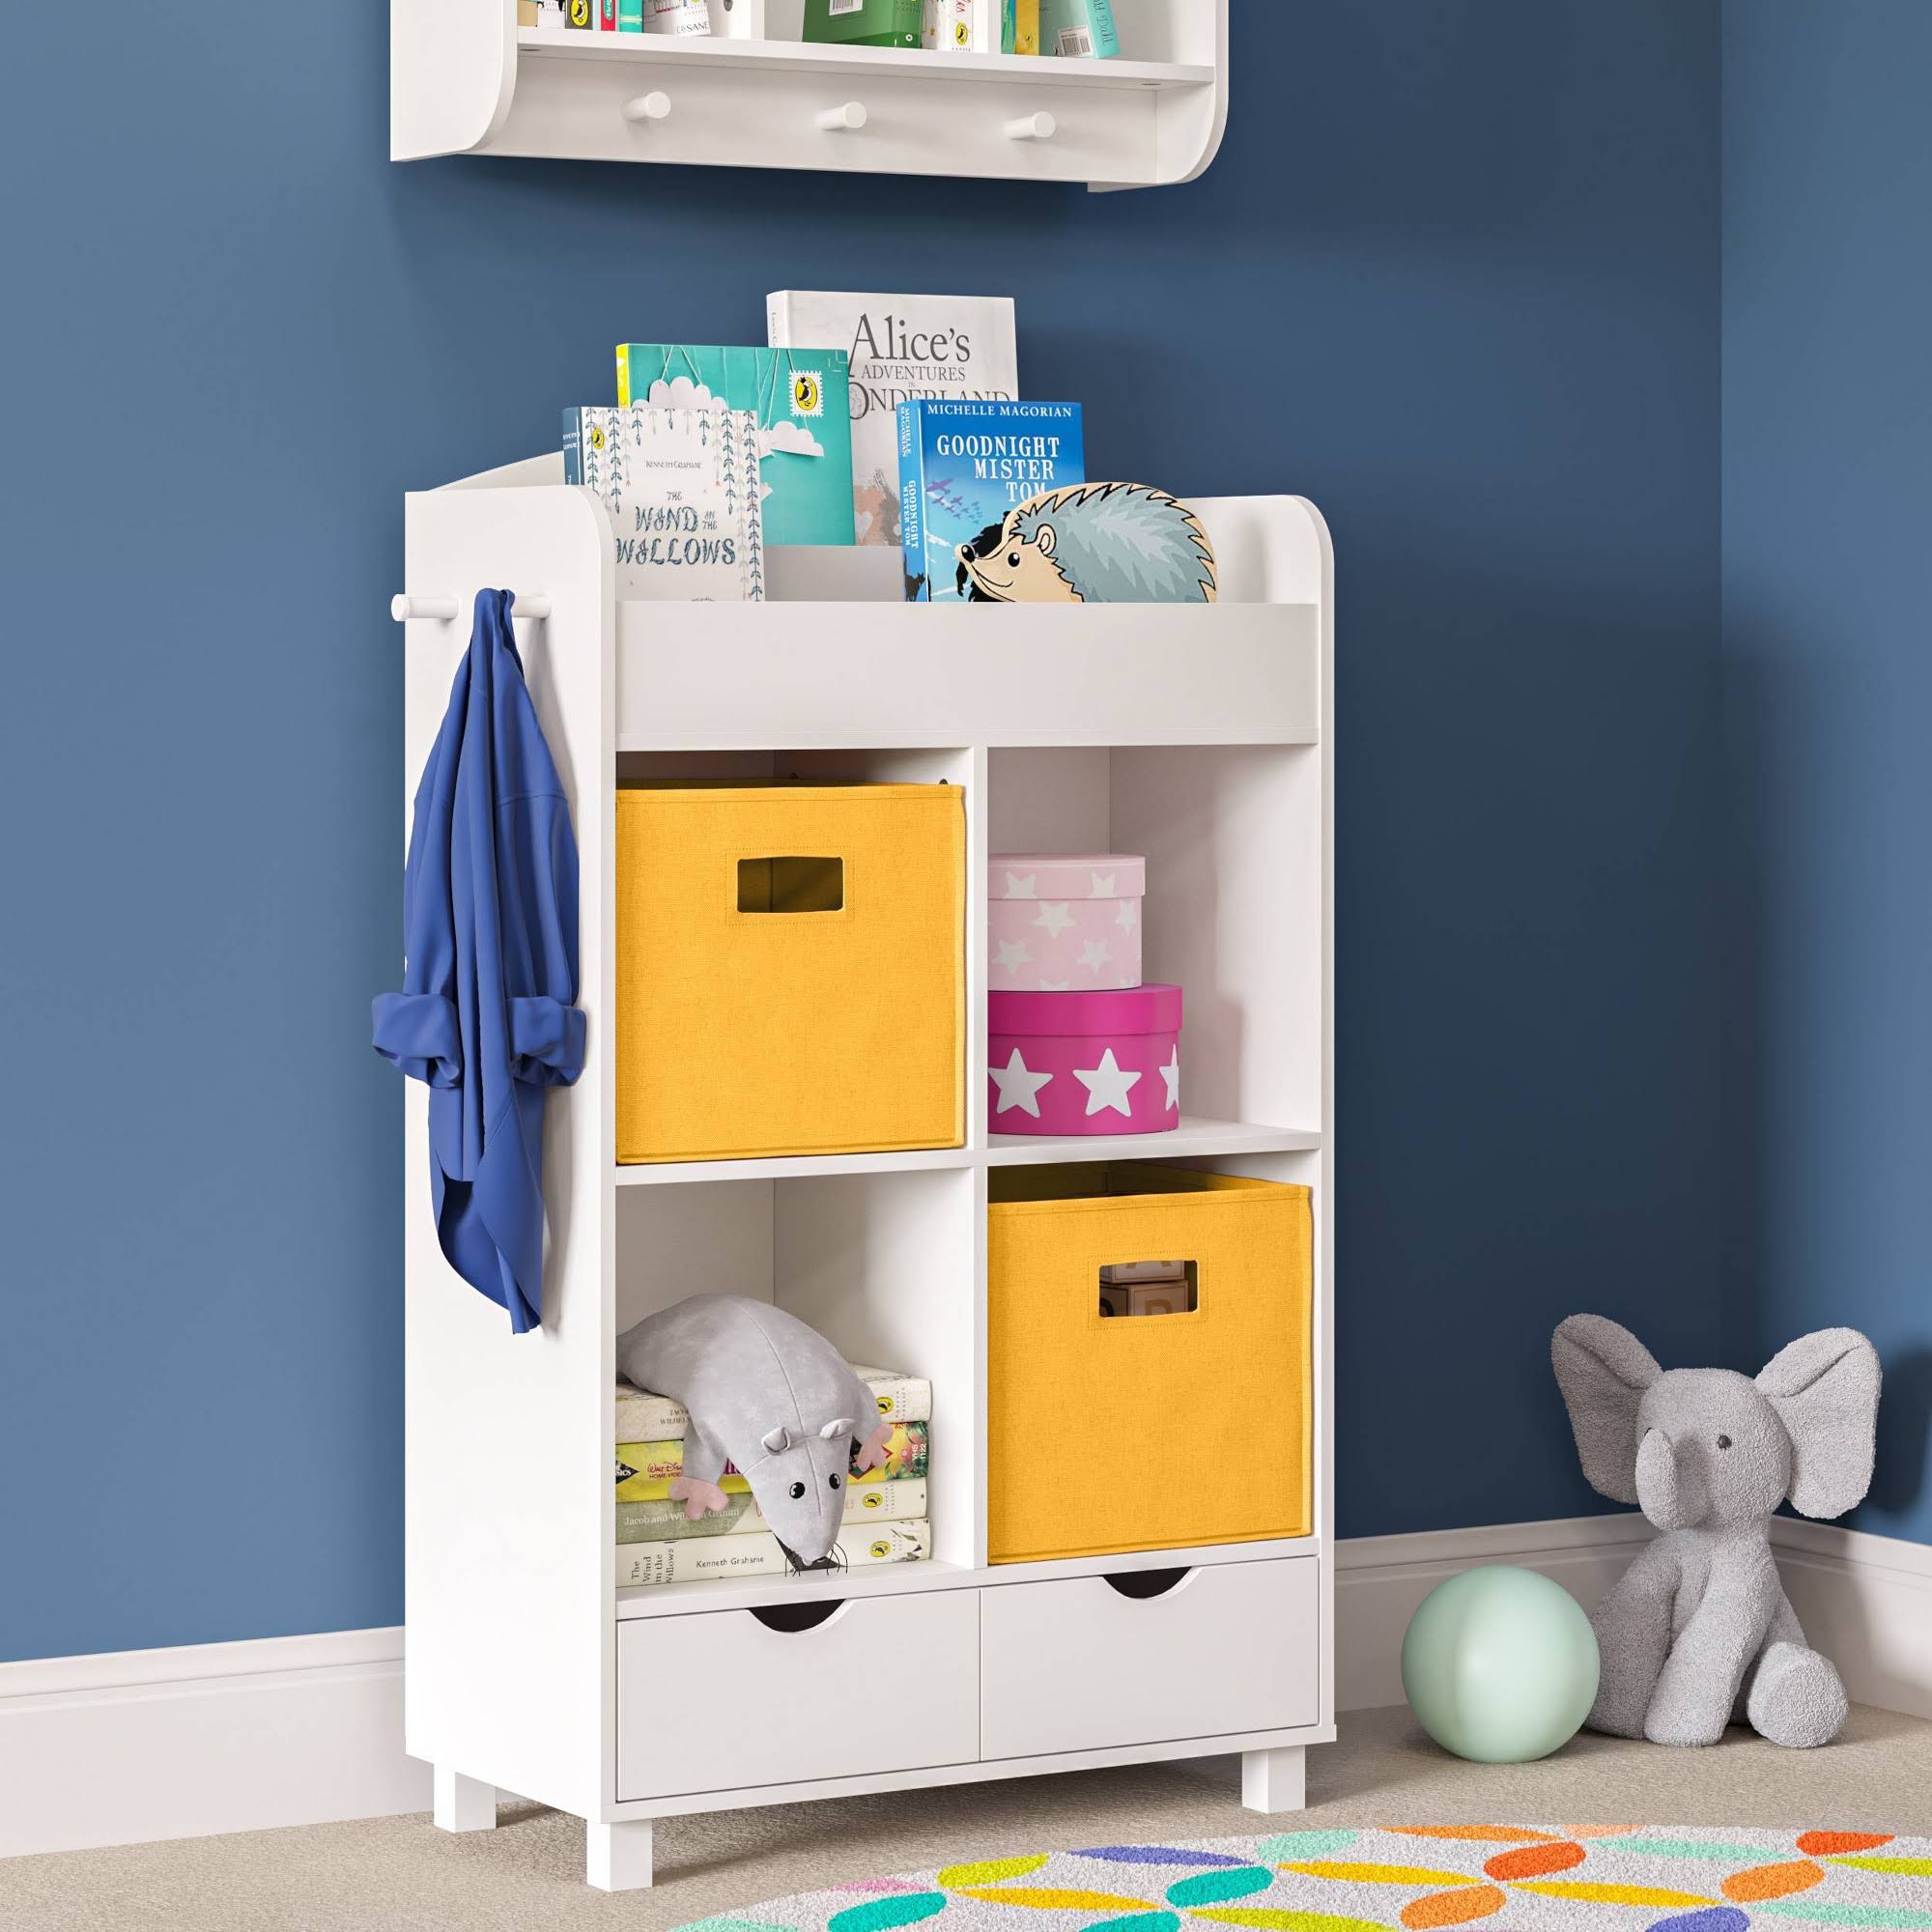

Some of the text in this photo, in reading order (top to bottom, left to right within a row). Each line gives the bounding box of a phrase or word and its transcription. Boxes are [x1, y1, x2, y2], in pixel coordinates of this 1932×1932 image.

[862, 365, 966, 382] ADVENTURES
[927, 404, 1072, 417] MICHELLE MAGORIAN
[937, 435, 1060, 458] GOODNIGHT
[974, 459, 1054, 480] MISTER
[666, 491, 682, 501] THE
[1006, 481, 1046, 502] TOM
[635, 506, 698, 532] WIND
[908, 479, 919, 550] GOODNIGHT
[702, 520, 718, 530] THE
[616, 537, 736, 565] WILLOWS
[624, 1516, 650, 1526] Jacob
[651, 1514, 668, 1522] and
[631, 1560, 640, 1580] The
[642, 1555, 652, 1582] Wind
[654, 1553, 663, 1570] the
[696, 1558, 728, 1569] Kenneth
